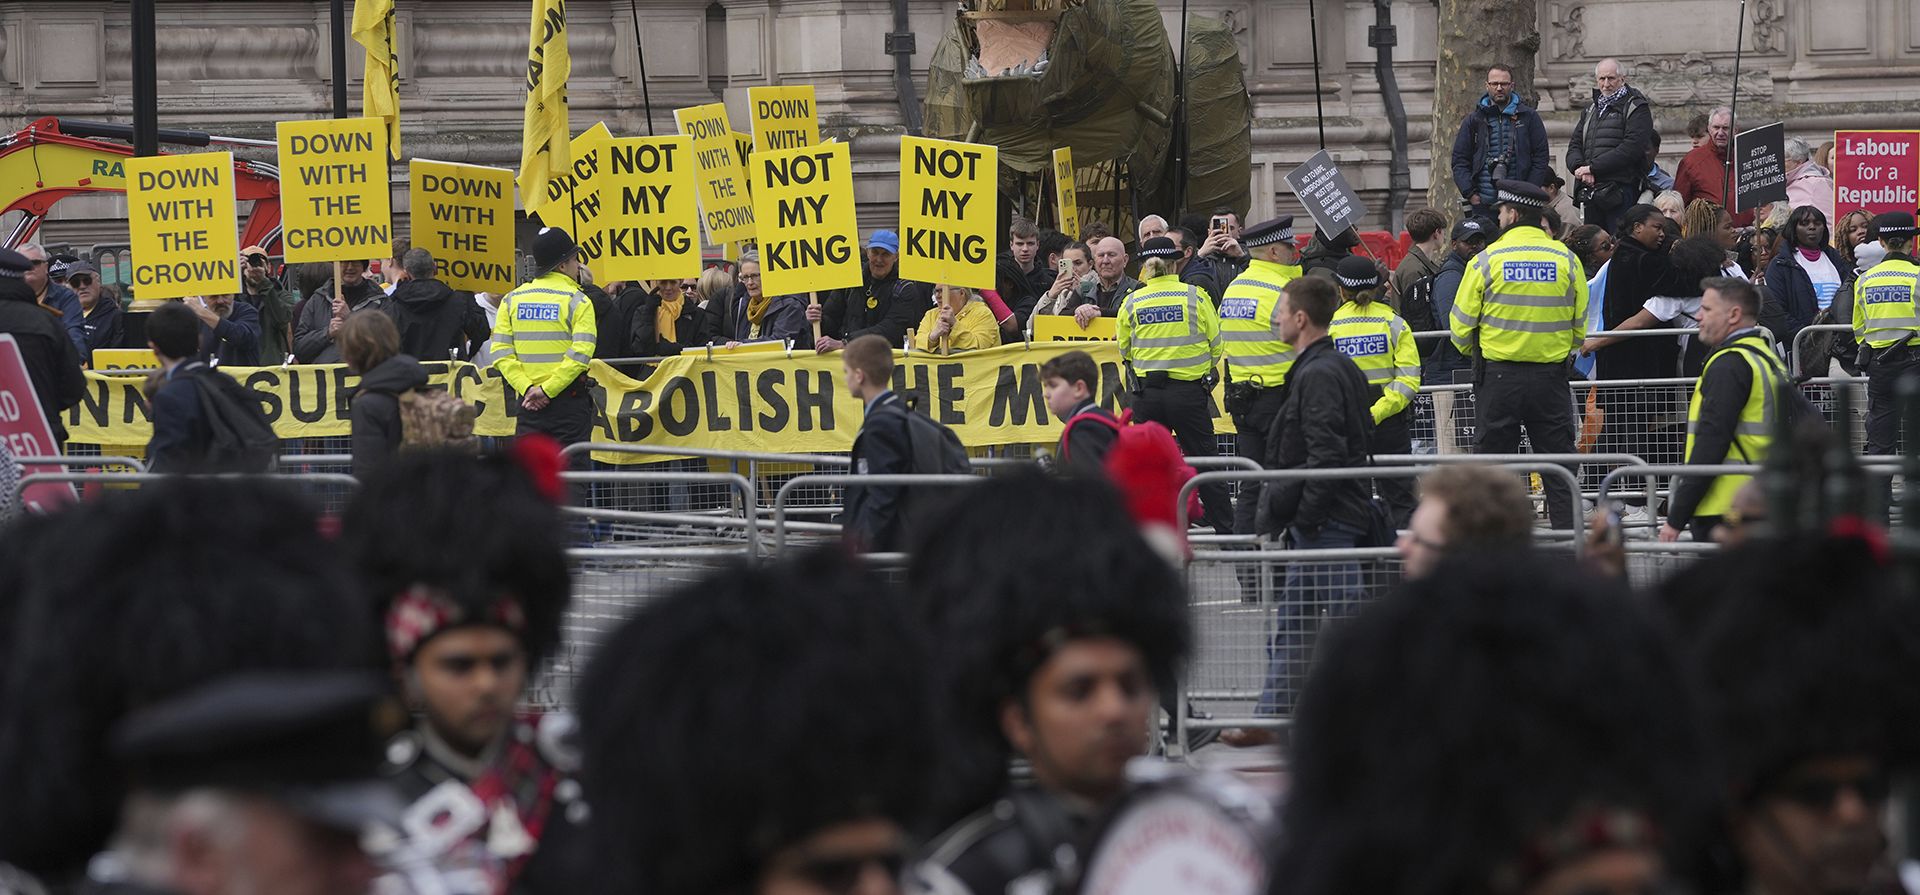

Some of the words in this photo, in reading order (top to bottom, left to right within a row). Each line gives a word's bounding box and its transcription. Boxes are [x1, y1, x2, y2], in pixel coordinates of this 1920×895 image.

[758, 100, 809, 119] DOWN
[687, 118, 726, 140] DOWN
[766, 130, 807, 149] WITH
[291, 132, 372, 155] DOWN
[1846, 138, 1909, 155] Labour
[611, 144, 677, 174] NOT
[697, 147, 730, 170] WITH
[915, 146, 981, 180] NOT
[139, 167, 218, 191] DOWN
[300, 164, 366, 185] WITH
[765, 152, 834, 188] NOT
[1754, 168, 1763, 178] THE
[1857, 162, 1881, 180] for
[1888, 167, 1897, 180] a
[423, 175, 501, 199] DOWN
[709, 178, 736, 199] THE
[1751, 181, 1760, 190] THE
[1839, 186, 1916, 207] Republic
[148, 199, 213, 222] WITH
[309, 195, 361, 216] THE
[622, 185, 671, 215] MY
[778, 194, 829, 228] MY
[921, 188, 972, 220] MY
[430, 203, 493, 225] WITH
[708, 205, 755, 231] CROWN
[157, 230, 208, 252] THE
[287, 225, 388, 248] CROWN
[437, 231, 487, 252] THE
[610, 226, 690, 256] KING
[906, 228, 987, 264] KING
[766, 235, 851, 271] KING
[136, 260, 234, 285] CROWN
[434, 258, 511, 282] ROWN
[1505, 268, 1554, 280] POLICE
[1867, 292, 1909, 303] POLICE
[519, 309, 557, 319] POLICE
[1139, 311, 1182, 323] POLICE
[1221, 306, 1255, 317] POLICE
[1339, 342, 1384, 355] POLICE
[588, 369, 835, 442] ABOLISH
[891, 364, 965, 424] HE
